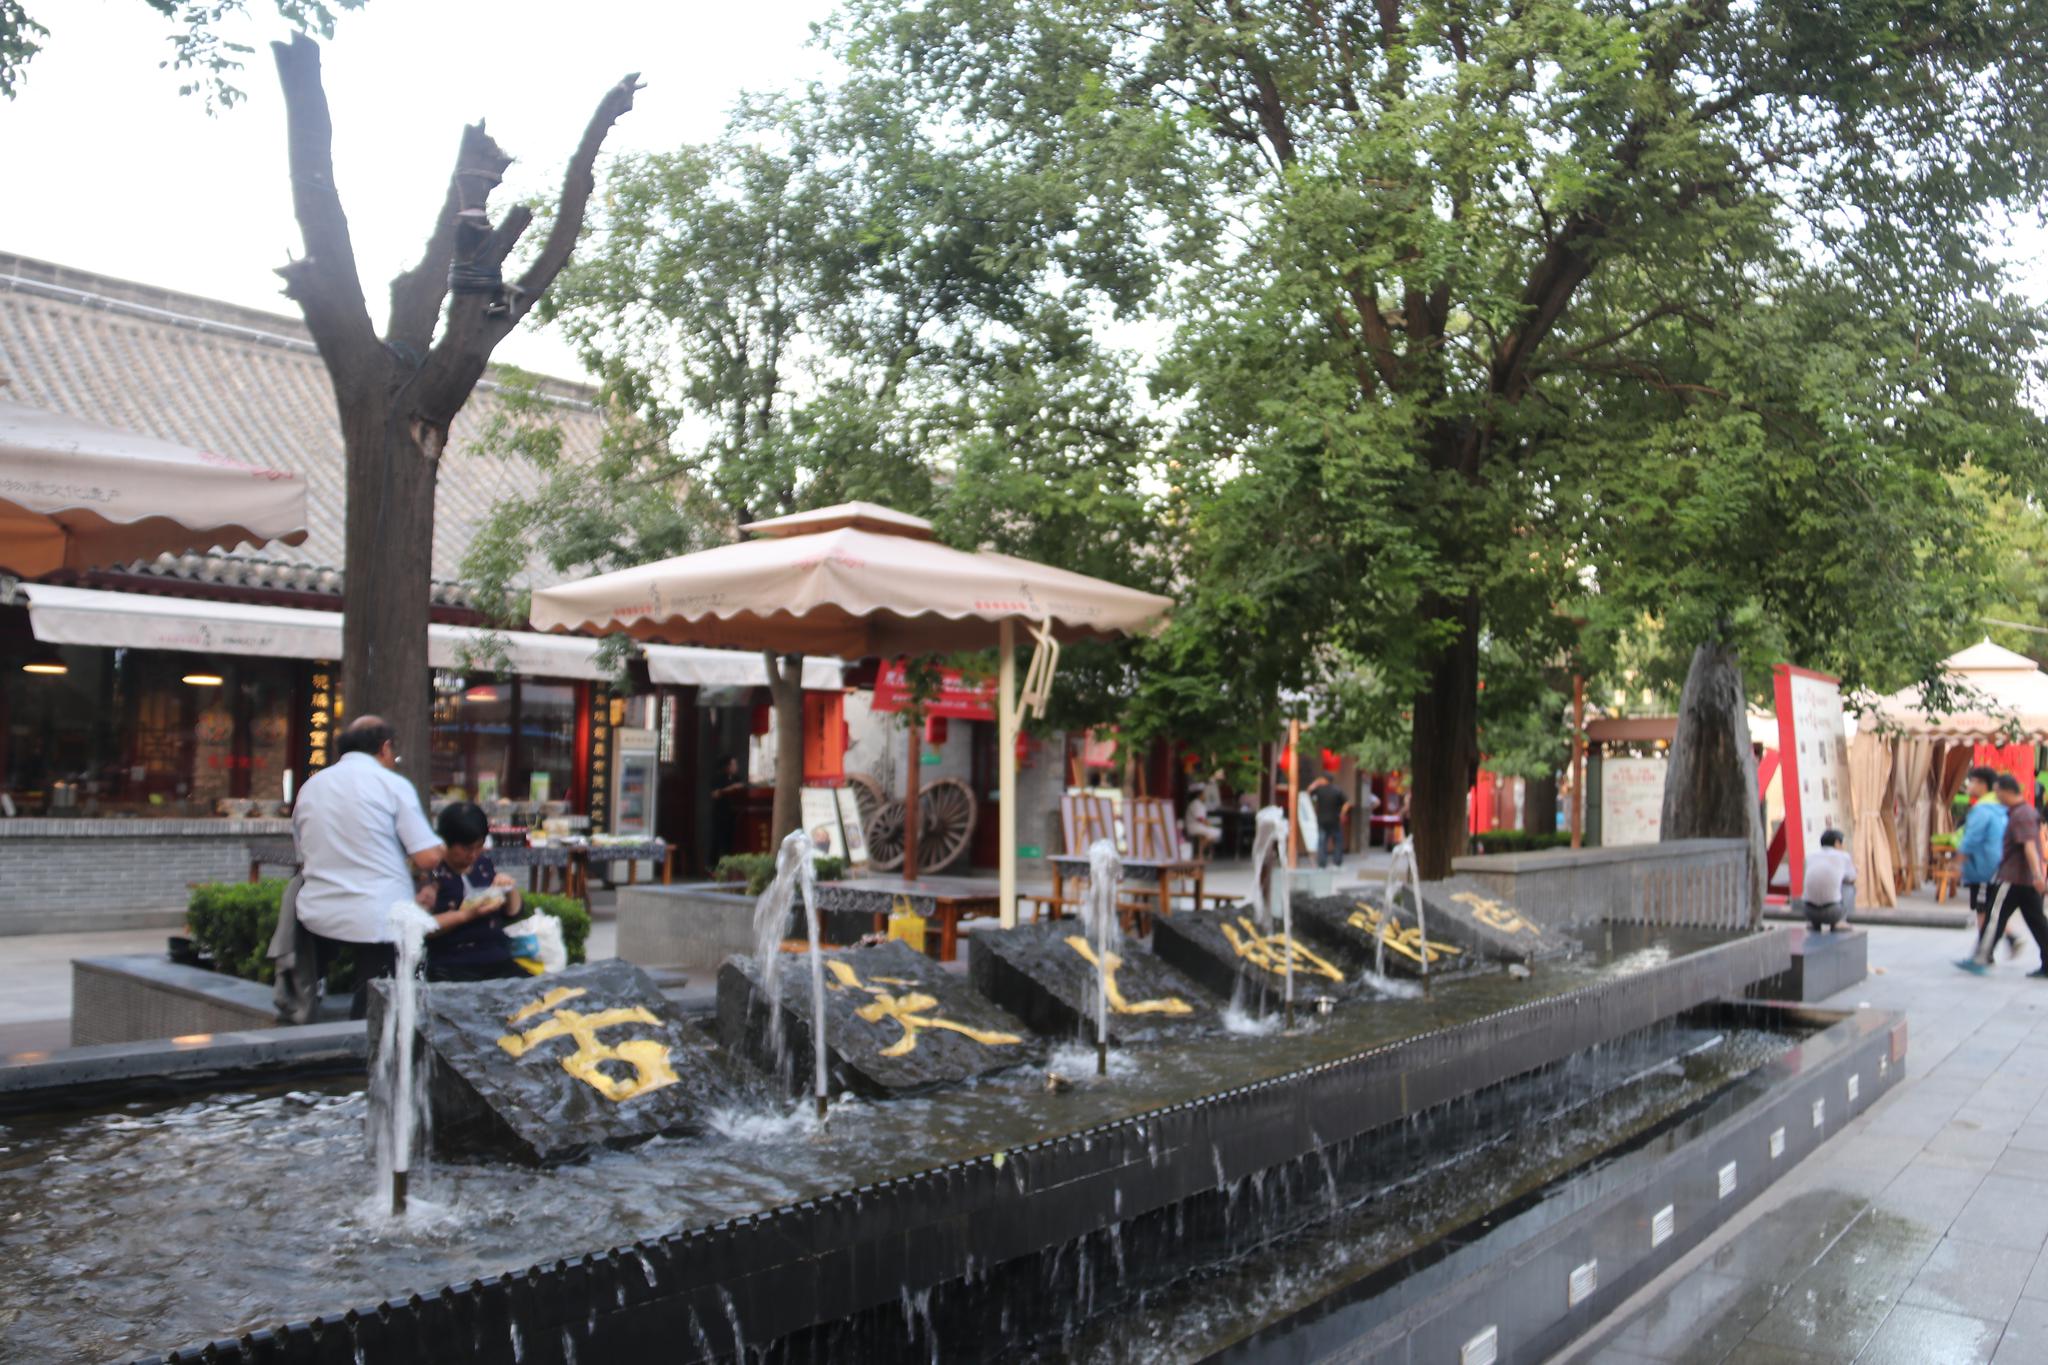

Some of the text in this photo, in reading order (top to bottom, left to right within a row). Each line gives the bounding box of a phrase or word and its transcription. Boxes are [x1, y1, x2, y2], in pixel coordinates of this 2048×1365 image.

[1064, 934, 1195, 1015] 上
[1220, 915, 1345, 983] 的
[496, 986, 682, 1102] 舌
[823, 959, 1024, 1057] 尖
